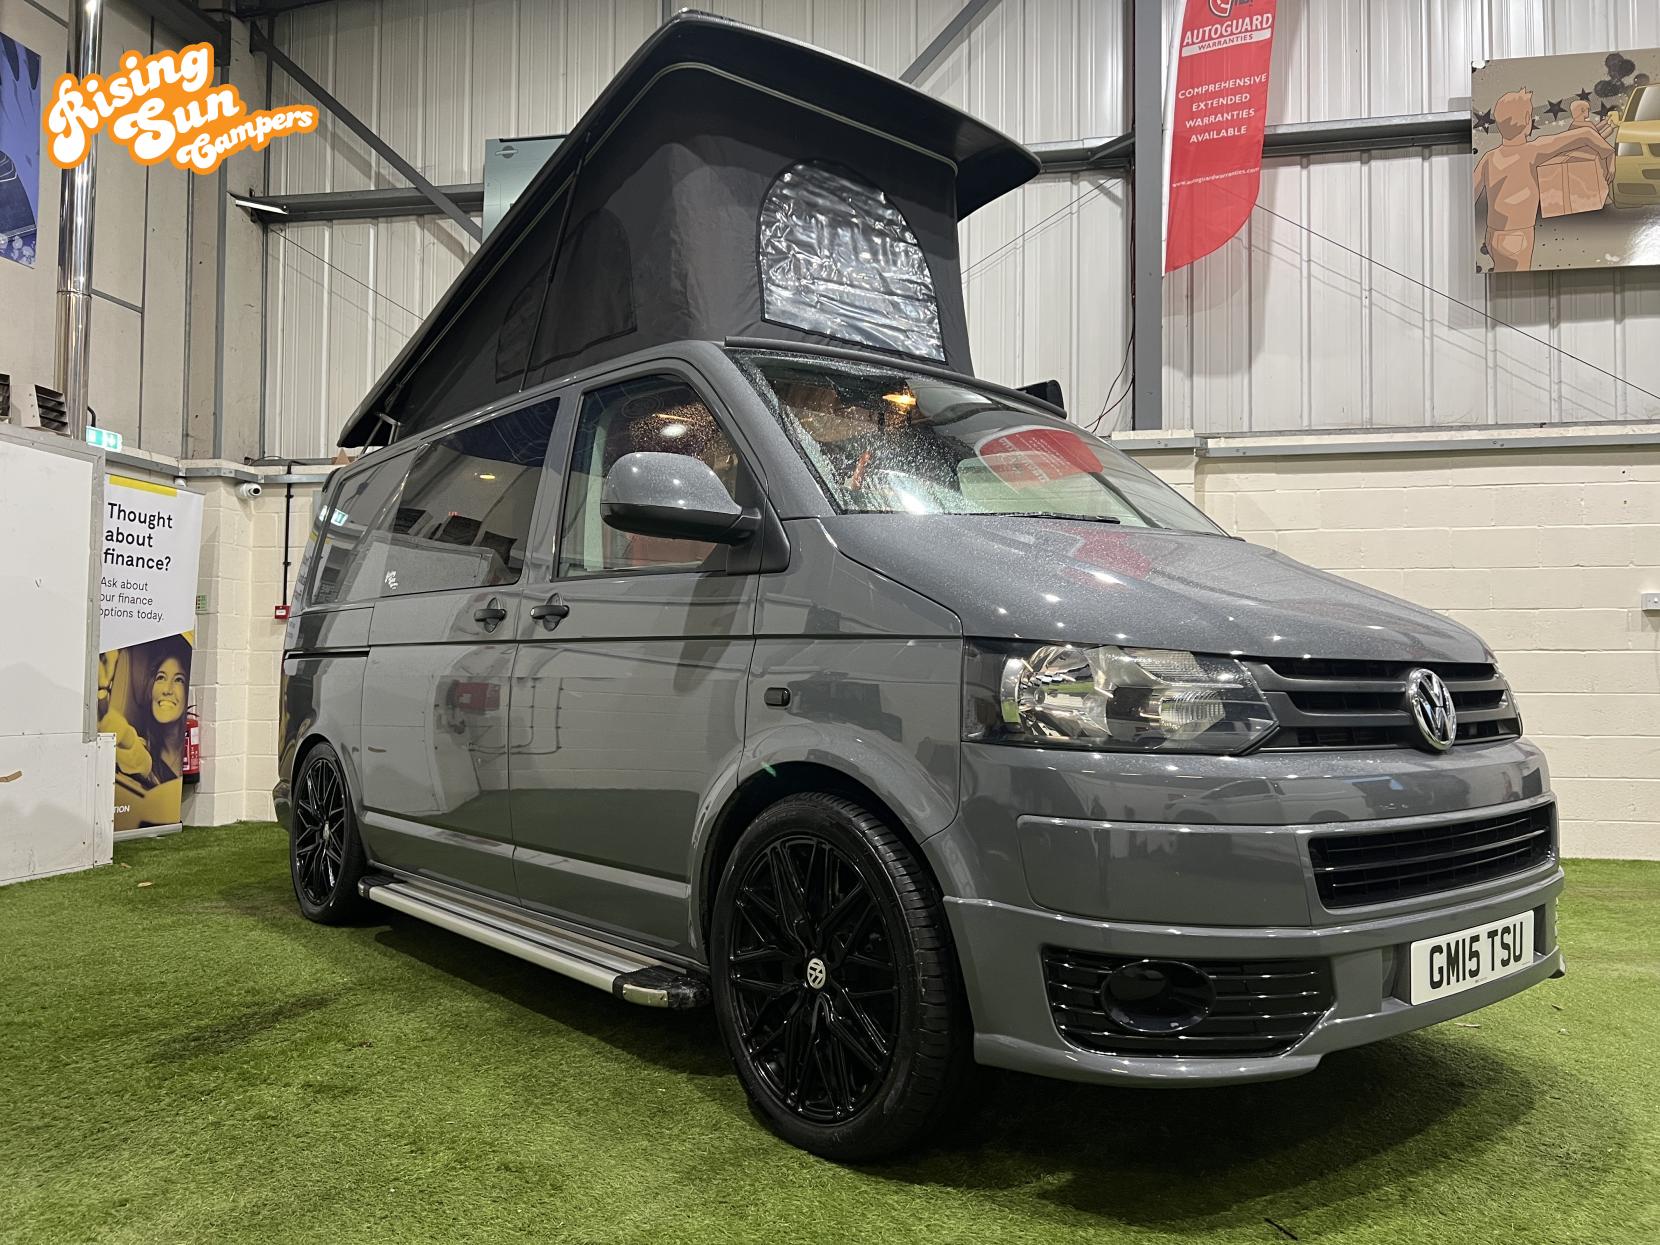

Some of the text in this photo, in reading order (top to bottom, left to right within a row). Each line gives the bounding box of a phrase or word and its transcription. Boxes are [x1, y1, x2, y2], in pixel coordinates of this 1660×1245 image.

[1183, 13, 1273, 46] AUTOGUARD
[1198, 33, 1254, 51] WARRANTIES
[1178, 73, 1267, 99] COMPREHENSIVE
[1192, 93, 1250, 112] EXTENDED
[1185, 108, 1255, 129] WARRANTIES
[1189, 125, 1248, 144] AVAILABLE
[107, 502, 173, 530] Thought
[105, 526, 153, 548] about
[103, 547, 171, 572] finance?
[100, 576, 148, 592] Ask about
[118, 592, 153, 606] finance
[137, 609, 165, 623] today.
[1487, 921, 1524, 972] TSU
